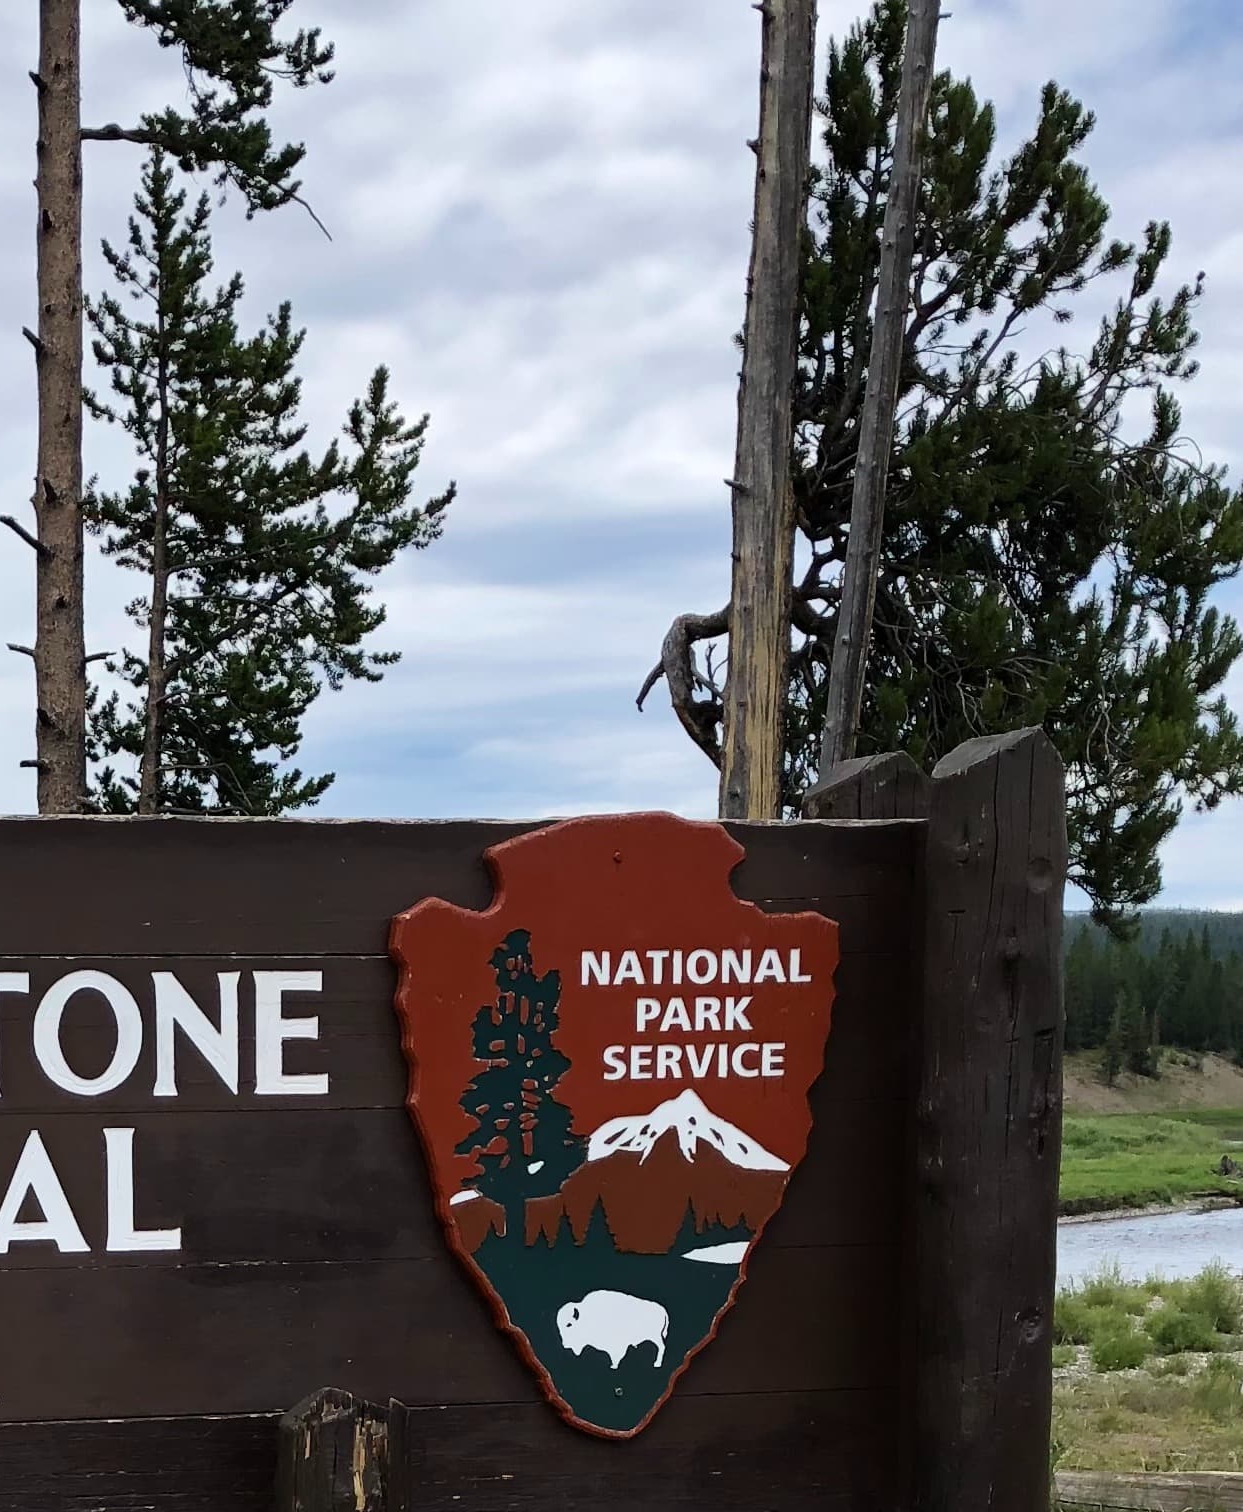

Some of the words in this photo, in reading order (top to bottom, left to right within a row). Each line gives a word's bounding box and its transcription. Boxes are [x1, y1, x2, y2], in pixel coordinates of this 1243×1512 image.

[581, 948, 812, 986] NATIONAL
[636, 996, 754, 1032] PARK
[603, 1042, 786, 1081] SERVICE
